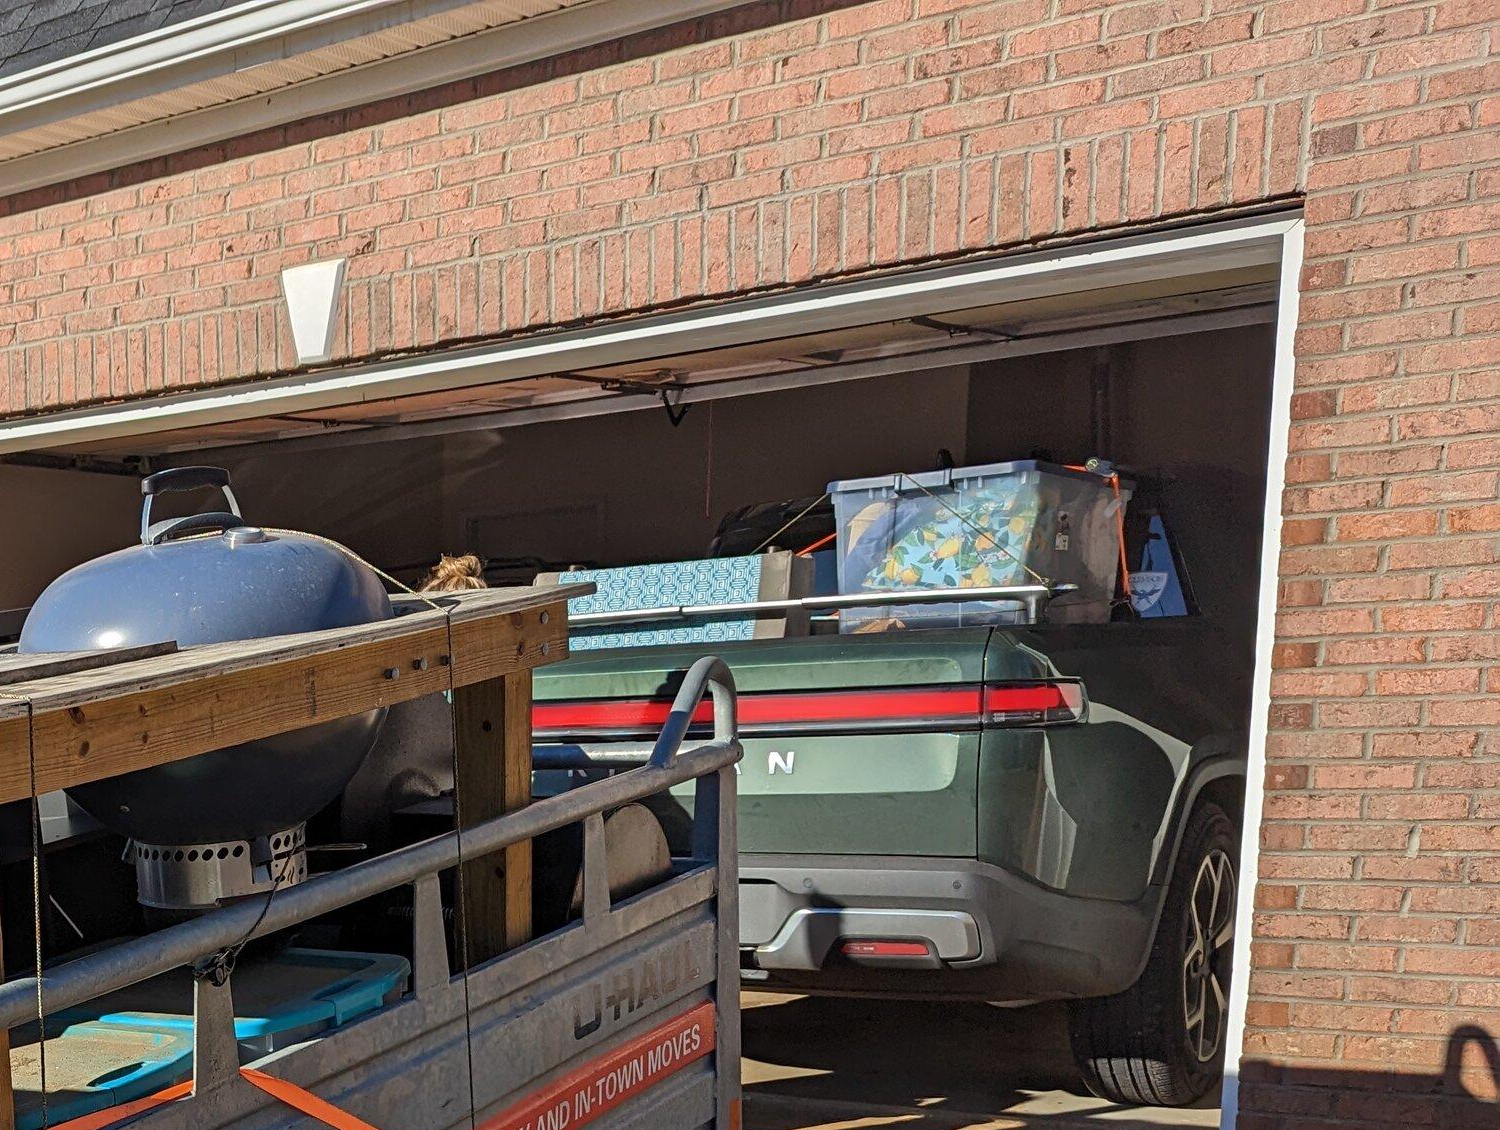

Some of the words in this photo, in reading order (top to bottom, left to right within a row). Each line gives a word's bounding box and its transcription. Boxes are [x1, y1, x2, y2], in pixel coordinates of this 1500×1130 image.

[572, 939, 701, 1041] U-HAUL
[574, 1058, 644, 1121] IN-TOWN
[647, 1023, 701, 1077] MOVES
